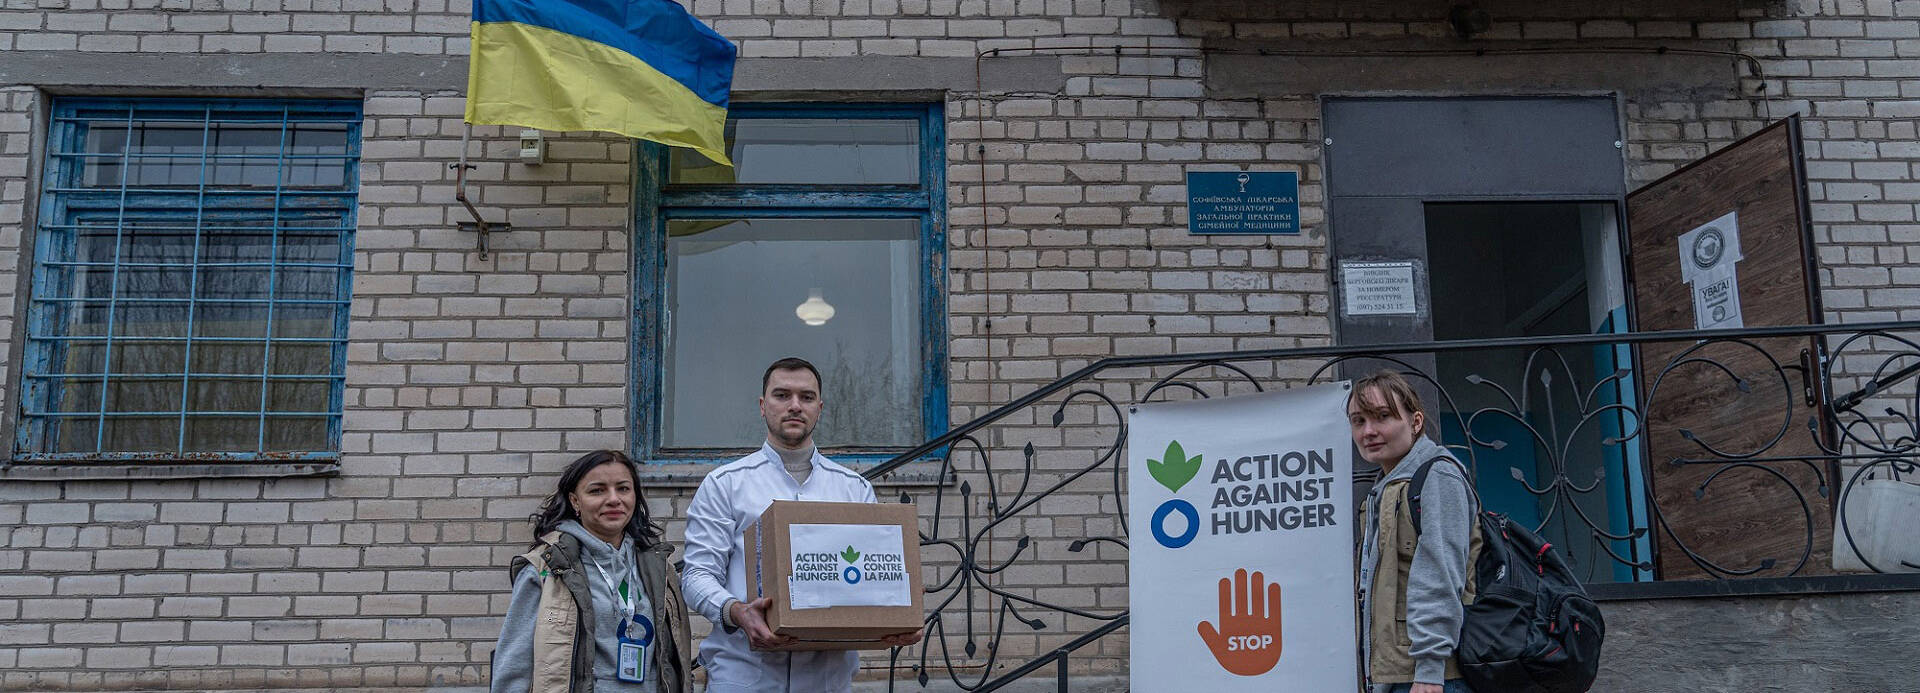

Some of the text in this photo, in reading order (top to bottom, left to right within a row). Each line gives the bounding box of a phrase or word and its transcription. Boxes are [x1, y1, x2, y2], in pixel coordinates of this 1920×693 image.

[1702, 280, 1729, 299] УВАГА!
[1211, 448, 1334, 484] ACTION
[1211, 477, 1334, 509] AGAINST
[1211, 503, 1337, 535] HUNGER
[795, 553, 838, 562] ACTION
[863, 553, 901, 562] ACTION
[795, 563, 838, 571] AGAINST
[863, 563, 902, 571] CONTRE
[795, 572, 840, 581] HUNGER
[864, 572, 903, 581] LA FAIM
[1228, 635, 1273, 651] STOP
